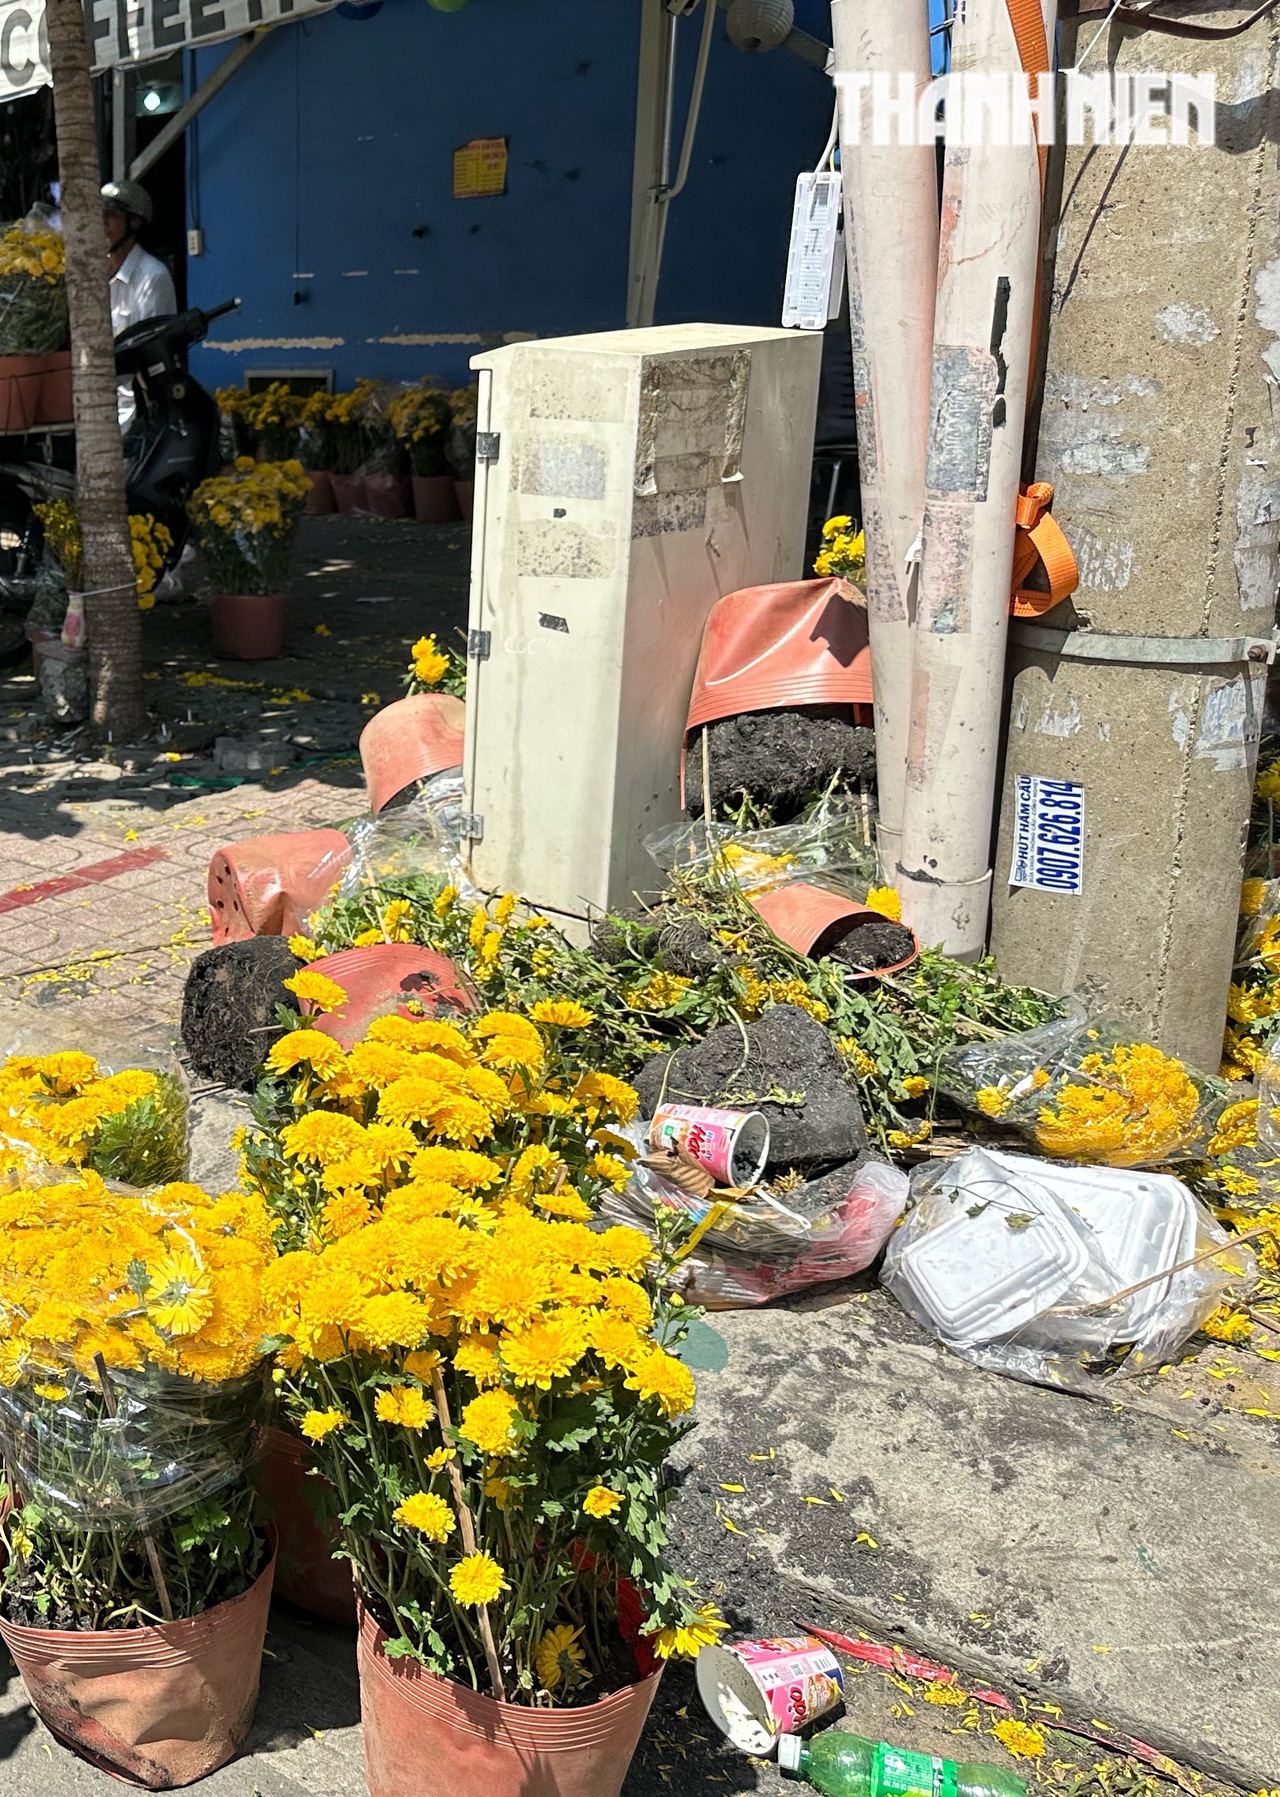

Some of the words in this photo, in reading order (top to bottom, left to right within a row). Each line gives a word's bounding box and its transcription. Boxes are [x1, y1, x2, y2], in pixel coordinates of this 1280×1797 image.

[1018, 776, 1032, 801] CẦU
[1018, 804, 1030, 832] HẦM
[1017, 834, 1029, 860] HÚT
[1036, 780, 1081, 889] 0907.626.814
